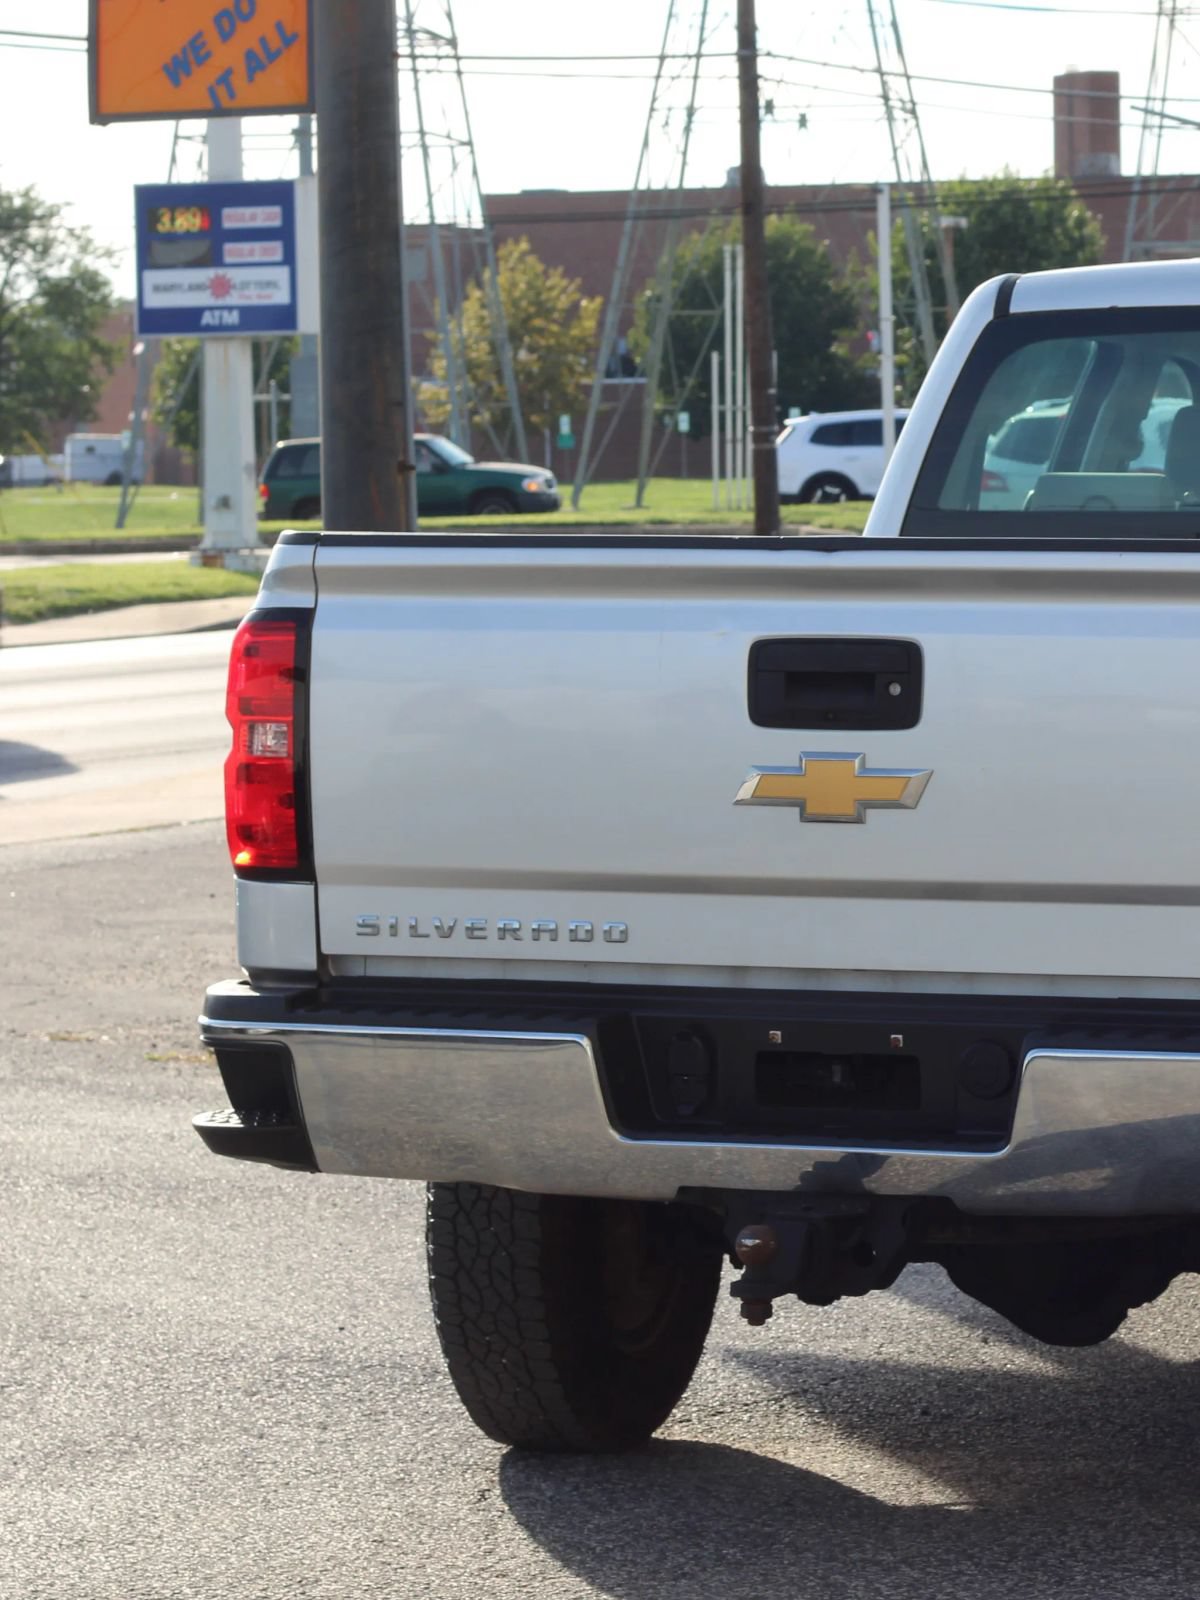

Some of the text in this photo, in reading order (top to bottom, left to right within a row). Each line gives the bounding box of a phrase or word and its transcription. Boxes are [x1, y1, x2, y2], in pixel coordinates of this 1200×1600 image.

[162, 0, 256, 89] WE DO
[207, 19, 299, 109] IT ALL
[201, 309, 240, 326] ATM
[355, 914, 629, 943] SILVERADO
